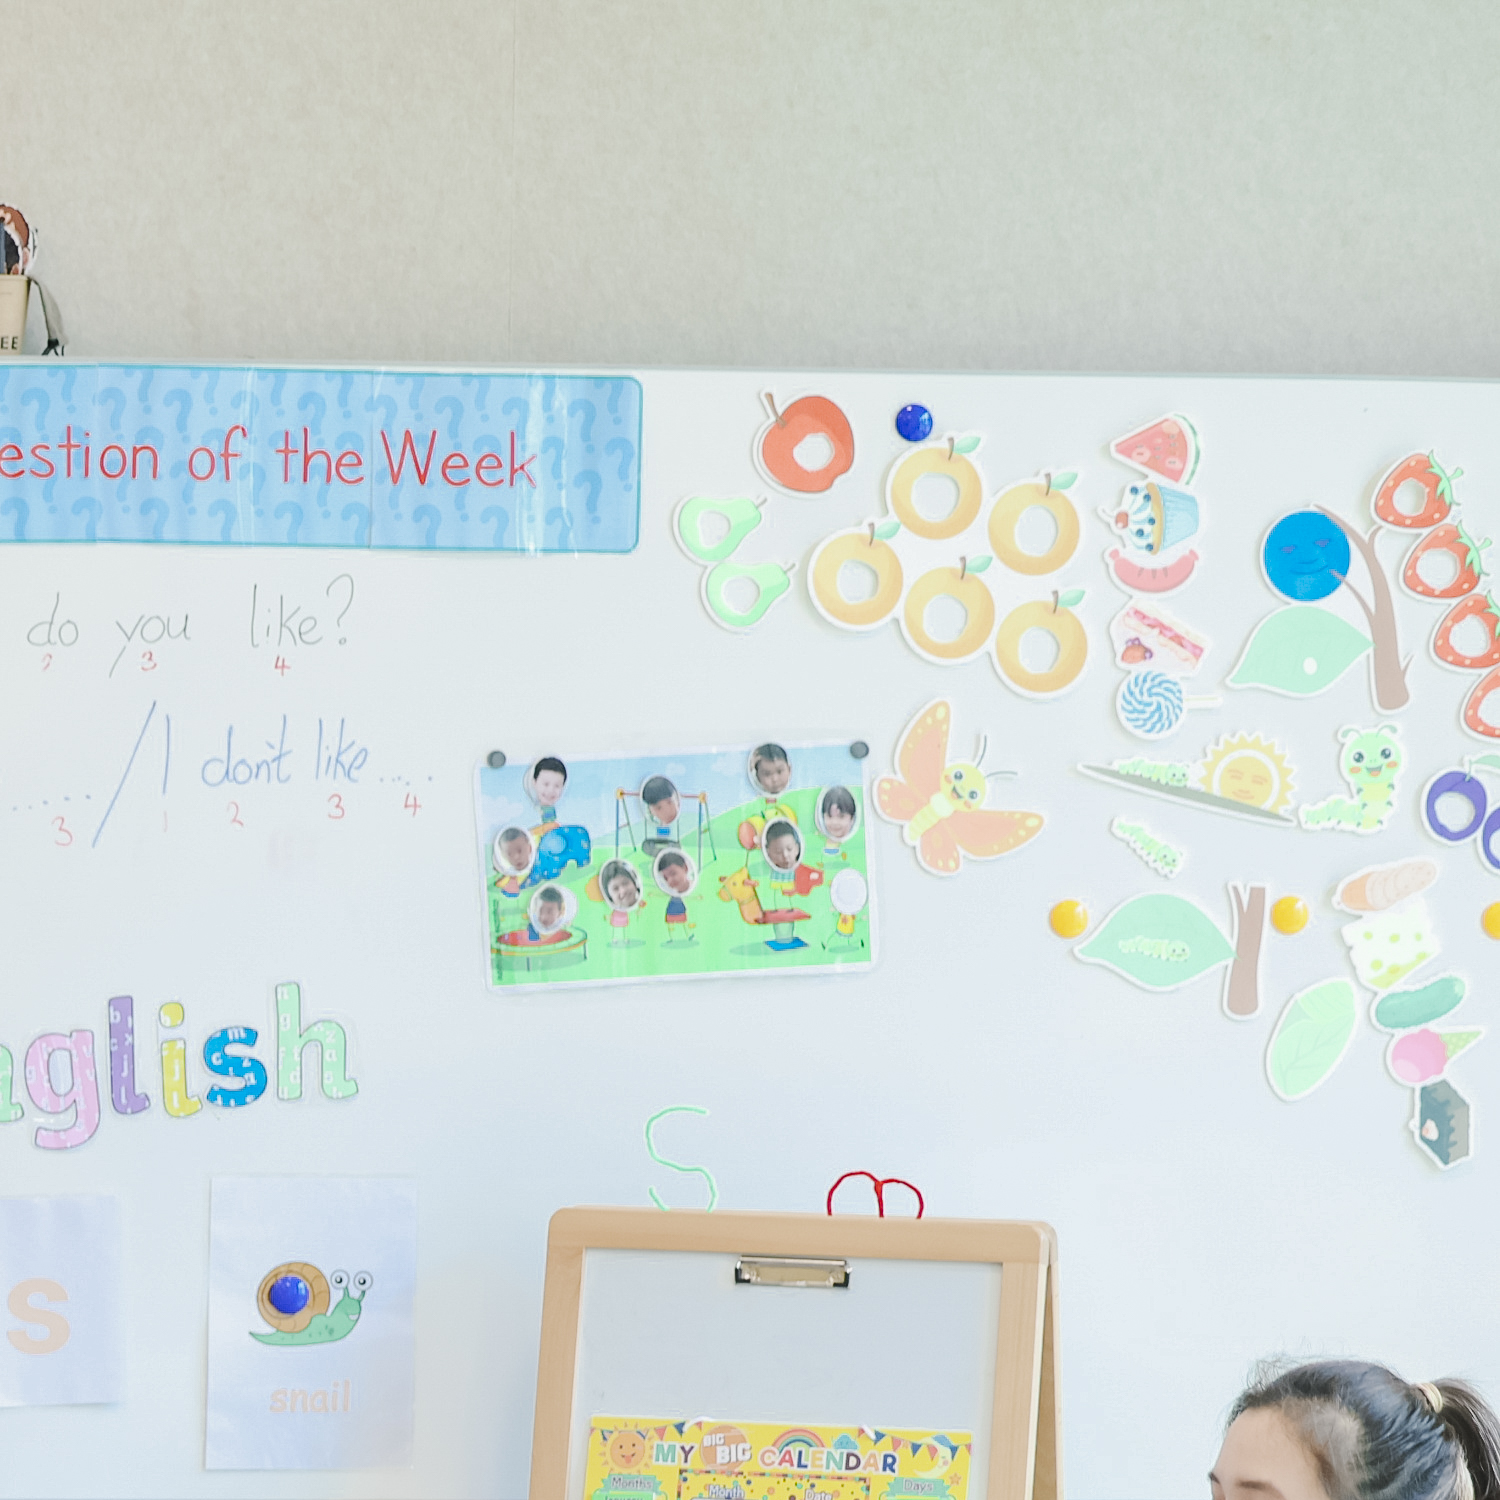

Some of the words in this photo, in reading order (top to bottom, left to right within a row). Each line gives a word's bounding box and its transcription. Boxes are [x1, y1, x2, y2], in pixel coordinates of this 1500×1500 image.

[188, 425, 249, 482] of
[275, 428, 365, 485] the
[381, 429, 538, 489] Week
[27, 591, 79, 647] do
[109, 613, 191, 679] you
[250, 573, 354, 648] like?
[140, 651, 157, 671] 3
[274, 655, 291, 676] 4
[201, 714, 293, 787] don't
[51, 816, 74, 847] 3
[328, 793, 345, 820] 3
[403, 793, 422, 817] 4
[268, 1379, 351, 1415] snail
[654, 1442, 696, 1466] MY
[702, 1433, 725, 1447] BIG
[716, 1443, 752, 1465] BIG
[759, 1446, 899, 1475] CALENDAR
[611, 1476, 654, 1489] Months
[709, 1484, 745, 1499] Month
[904, 1479, 934, 1494] Days
